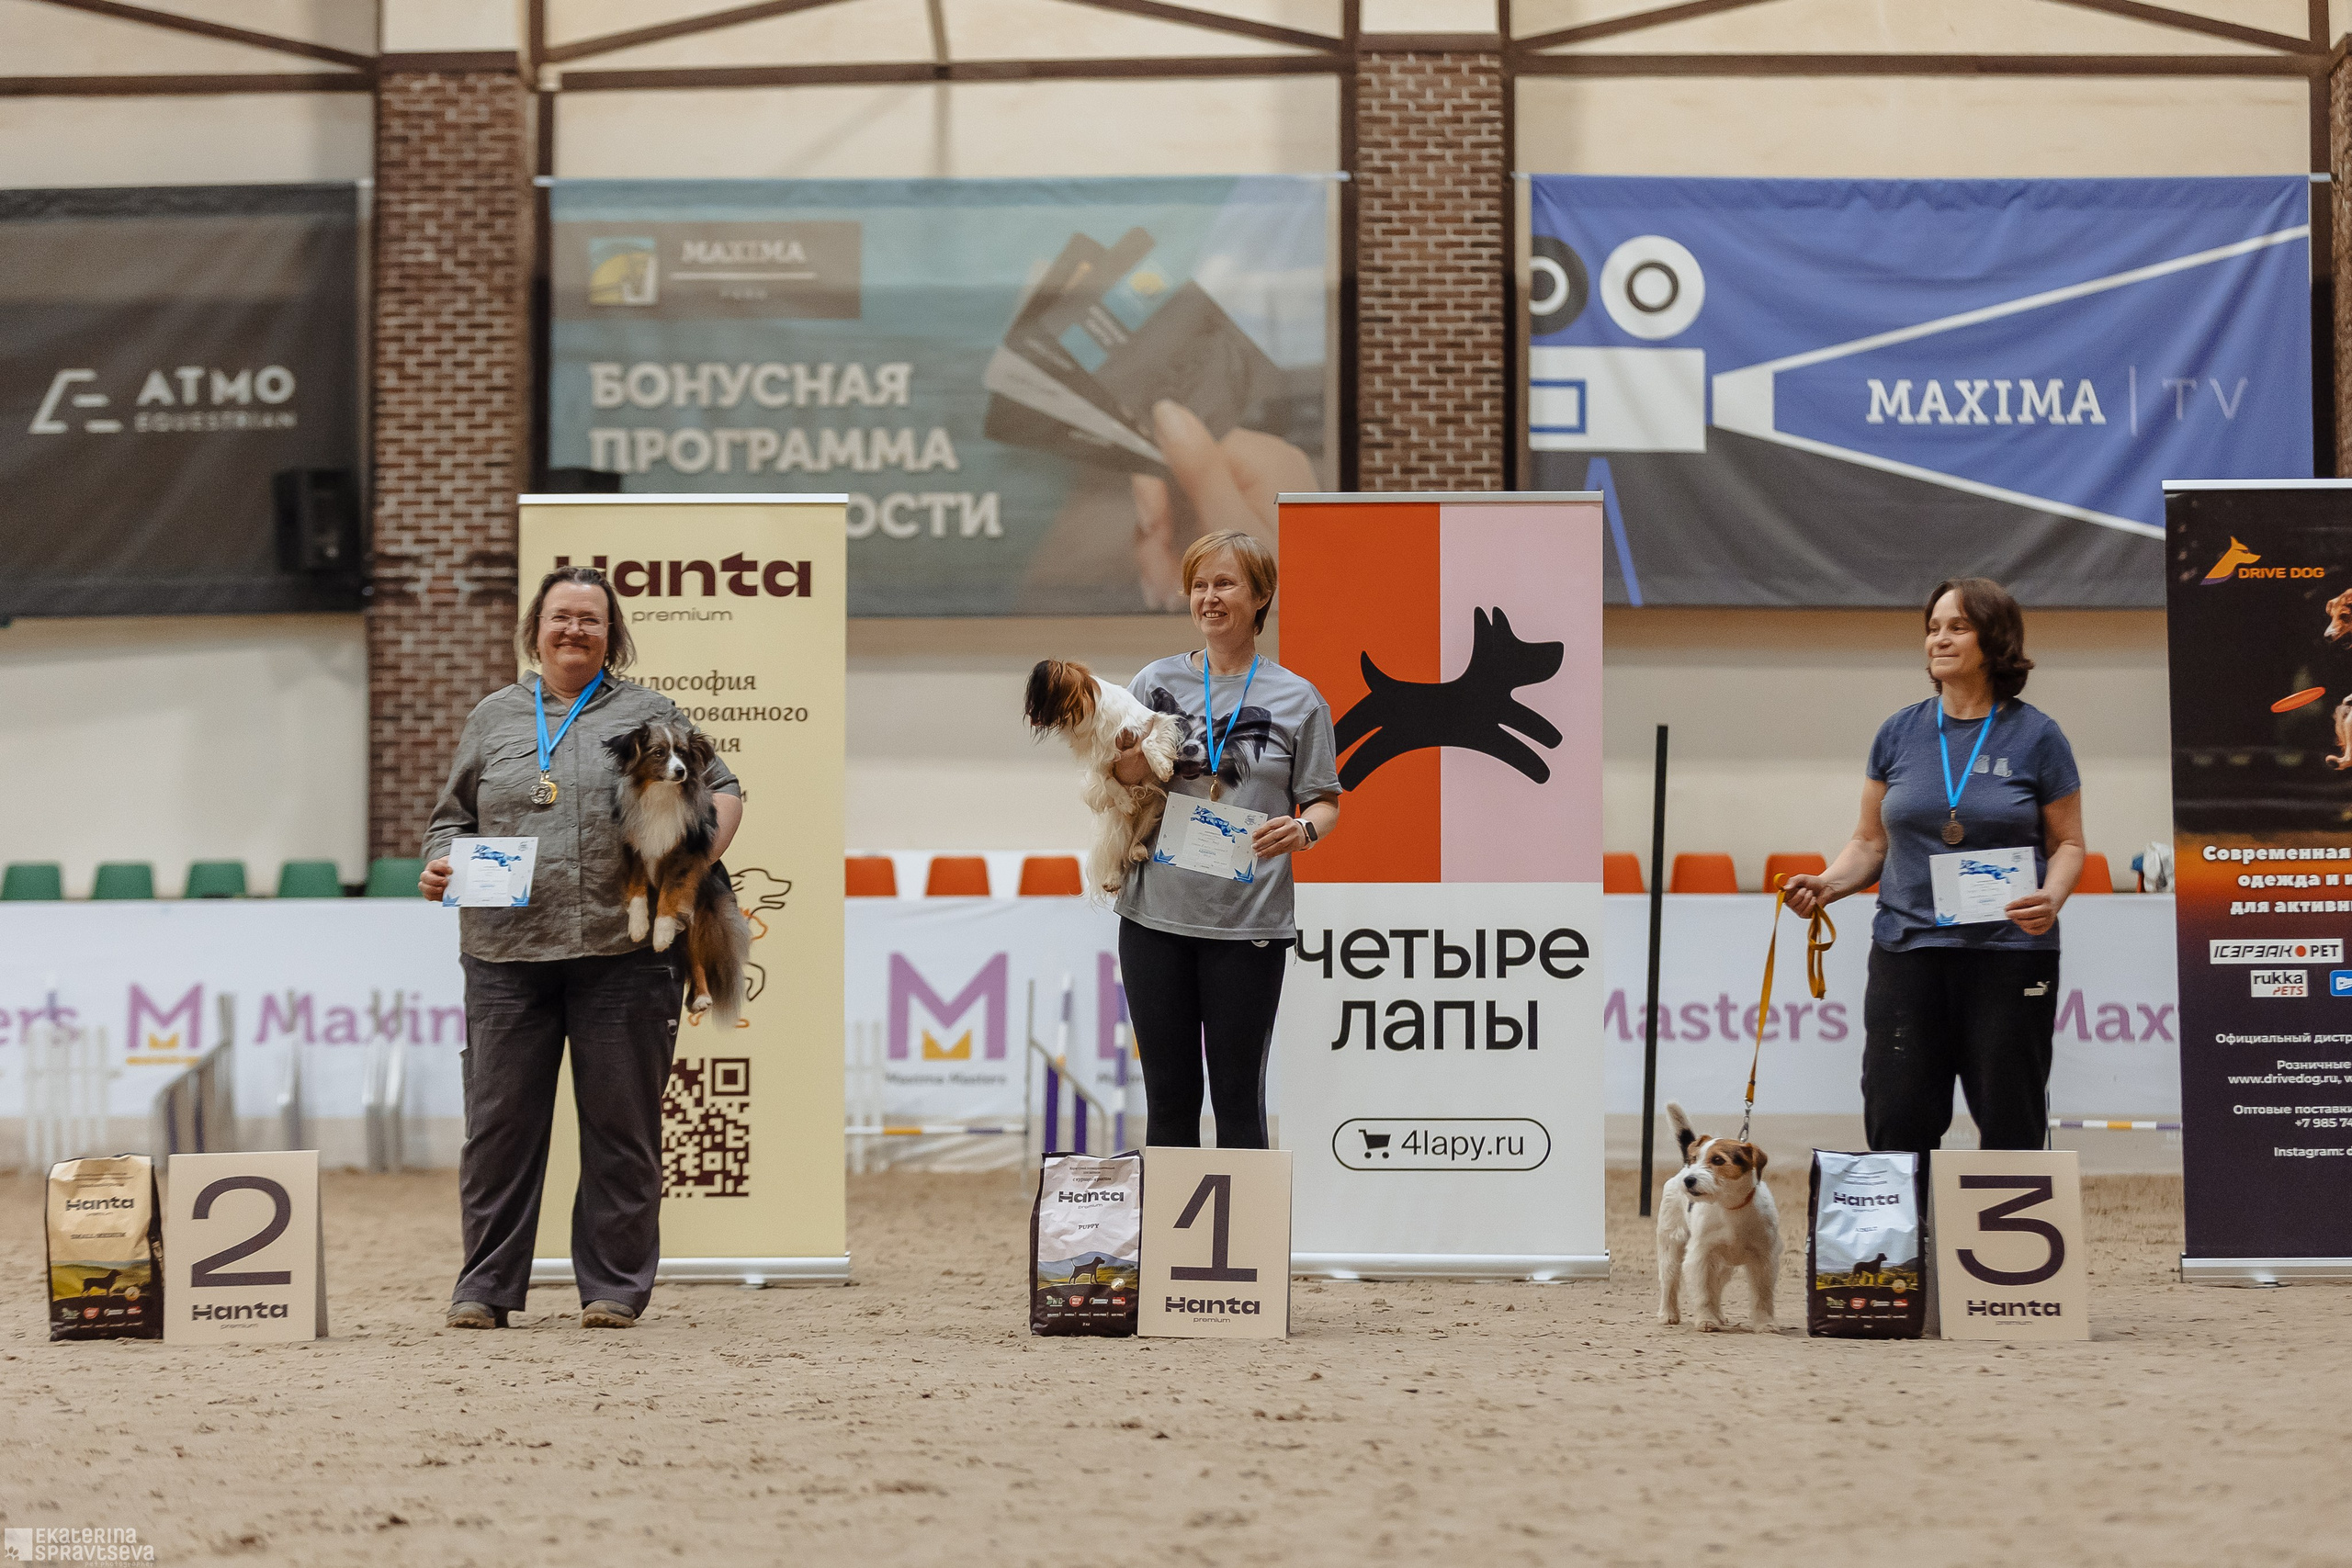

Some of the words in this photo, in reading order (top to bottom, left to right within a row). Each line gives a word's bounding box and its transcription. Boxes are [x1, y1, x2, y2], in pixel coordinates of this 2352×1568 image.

[135, 364, 297, 406] ATMO
[589, 362, 912, 409] БОНУСНАЯ
[1866, 378, 2107, 425] MAXIMA
[2162, 377, 2249, 420] TV
[133, 411, 298, 433] EQUESTRIAN
[589, 428, 958, 473] ПРОГРАММА
[2238, 567, 2287, 579] DRIVE
[2290, 567, 2325, 579] DOG
[632, 607, 732, 623] premium
[2203, 846, 2351, 864] Современная
[2237, 874, 2322, 888] одежда
[2325, 874, 2340, 886] и
[2230, 901, 2270, 915] для
[2274, 900, 2352, 914] активн
[1295, 927, 1590, 980] четыре
[2309, 943, 2339, 957] PET
[2253, 971, 2304, 985] rukka
[1330, 998, 1538, 1052] лапы
[2215, 1032, 2311, 1045] Официальный
[2277, 1060, 2351, 1069] Розничные
[2233, 1105, 2291, 1114] Оптовые
[2294, 1118, 2311, 1128] +7
[2312, 1118, 2337, 1128] 985
[1401, 1130, 1524, 1161] 4lapy.ru
[2274, 1147, 2345, 1158] Instagram:
[66, 1196, 135, 1212] Hanta
[1058, 1190, 1125, 1202] Hanta
[1833, 1191, 1900, 1207] Hanta
[190, 1176, 292, 1288] 2
[1170, 1174, 1258, 1282] 1
[1955, 1175, 2065, 1286] 3
[192, 1301, 288, 1321] Hanta
[1165, 1296, 1261, 1315] Hanta
[1967, 1299, 2062, 1317] Hanta
[220, 1322, 259, 1330] premium
